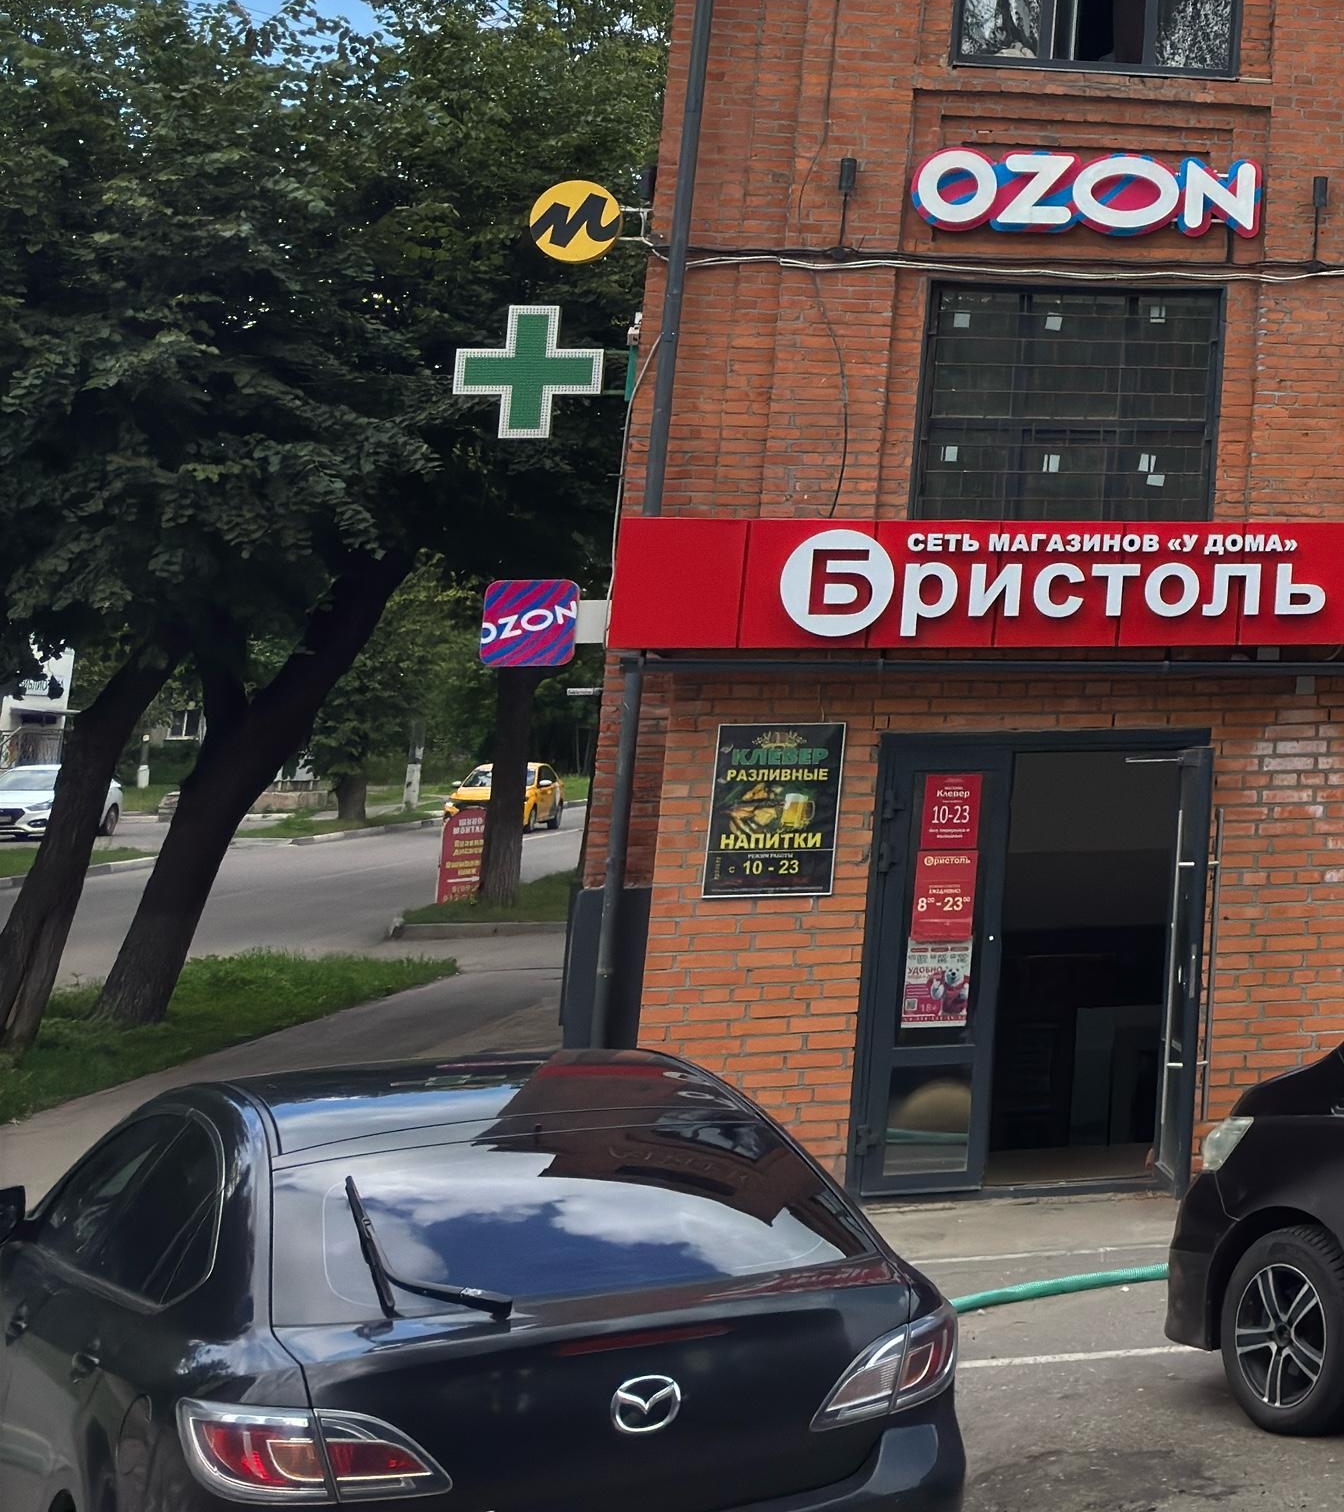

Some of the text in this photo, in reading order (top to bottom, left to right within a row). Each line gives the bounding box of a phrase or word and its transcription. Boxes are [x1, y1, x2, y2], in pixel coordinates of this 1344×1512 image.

[915, 147, 1259, 235] OZON
[906, 532, 1299, 556] СЕТЬ МАГАЗИНОВ «У ДОМА»
[780, 529, 1327, 638] Бристоль
[481, 599, 578, 646] OZON
[731, 747, 829, 766] КЛЕВЕР
[726, 768, 829, 782] РАЗЛИВНЫЕ
[936, 789, 970, 799] Клевер
[931, 805, 970, 824] 10-23
[720, 832, 823, 851] НАПИТКИ
[743, 860, 763, 875] 10
[778, 859, 800, 875] 23
